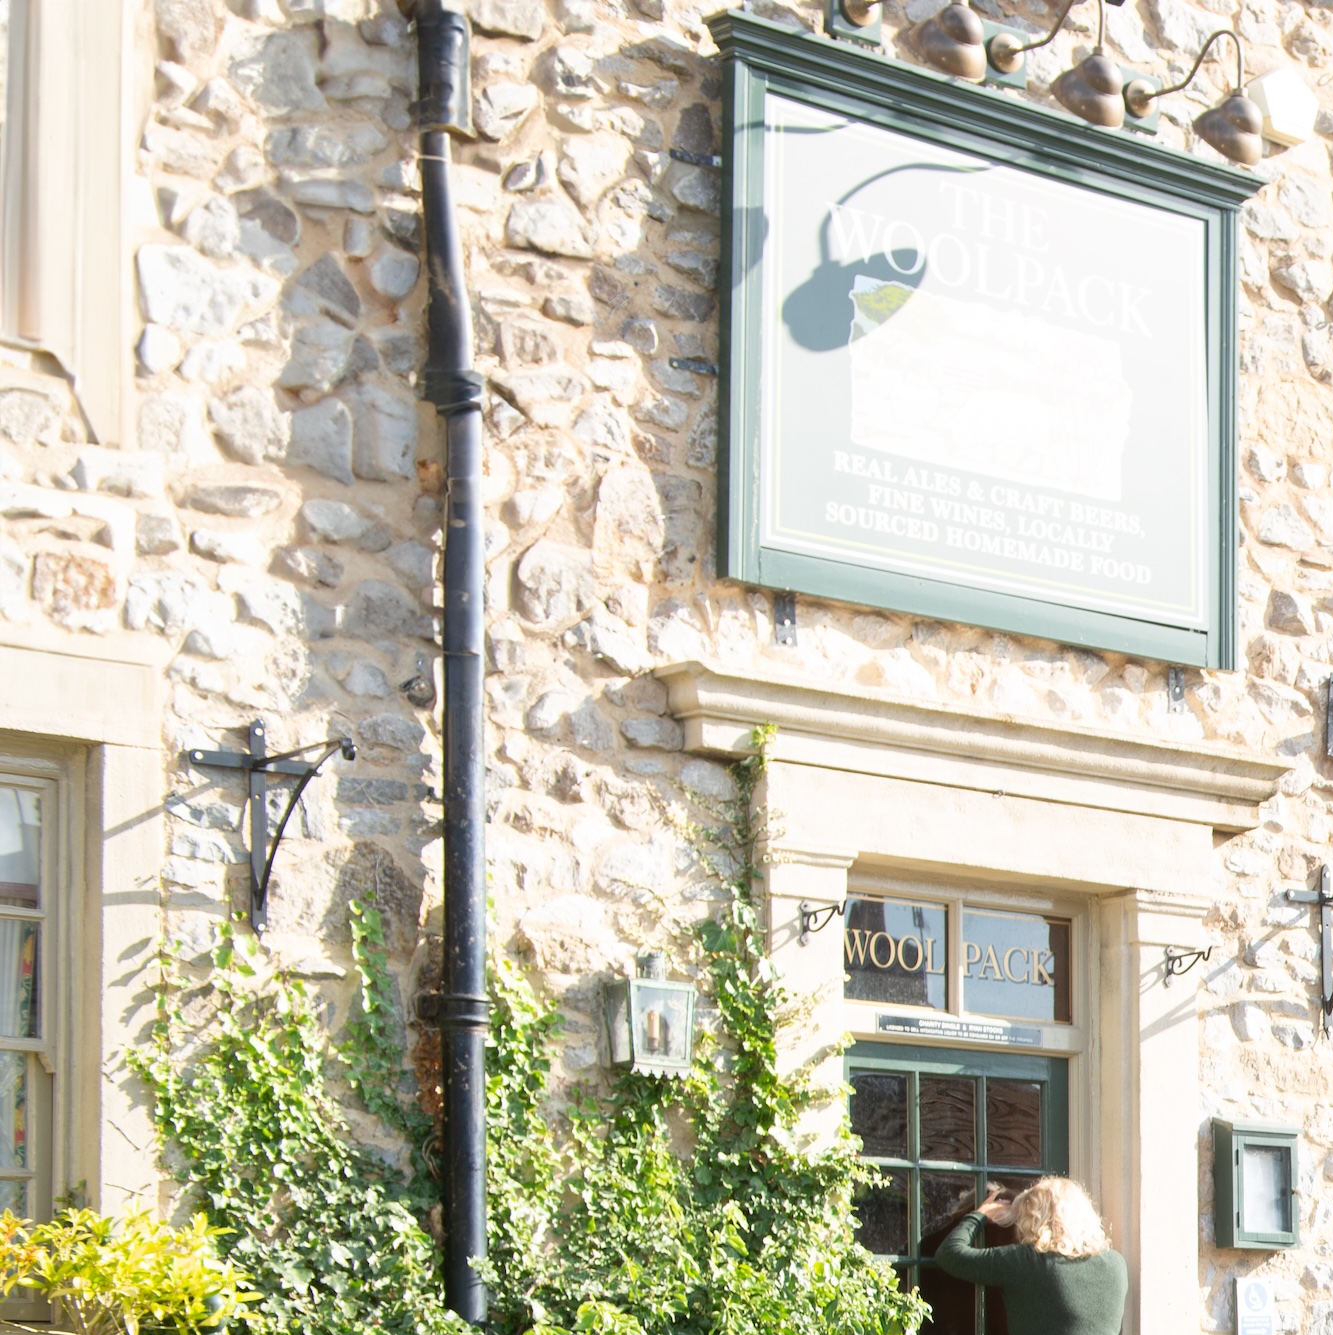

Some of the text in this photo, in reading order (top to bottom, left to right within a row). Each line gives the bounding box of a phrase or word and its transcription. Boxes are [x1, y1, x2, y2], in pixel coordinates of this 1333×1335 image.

[939, 181, 1050, 252] THE
[825, 202, 1154, 338] WOOLPACK
[834, 450, 1146, 538] REAL ALES & CRAFT BEERS,
[868, 484, 1115, 553] FINE WINES, LOCALLY
[825, 501, 1152, 584] SOURCED HOMEMADE FOOD
[844, 928, 1055, 987] WOOL PACK
